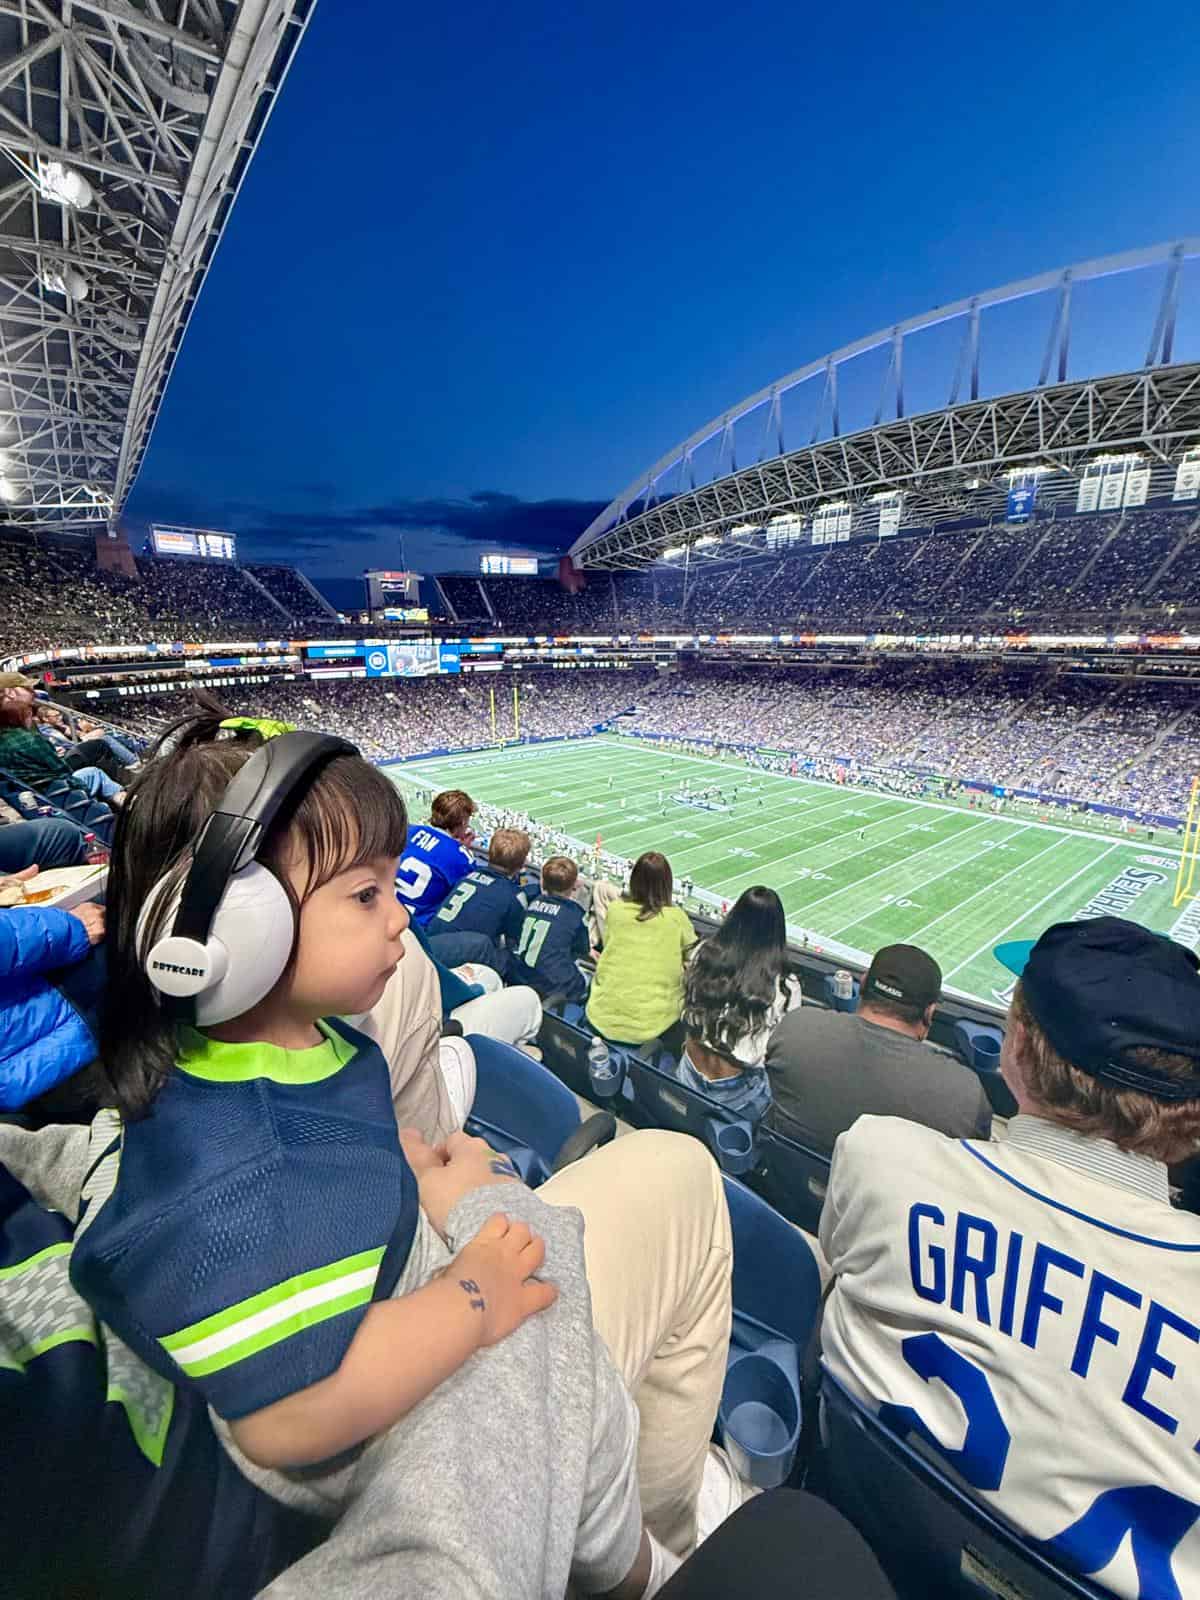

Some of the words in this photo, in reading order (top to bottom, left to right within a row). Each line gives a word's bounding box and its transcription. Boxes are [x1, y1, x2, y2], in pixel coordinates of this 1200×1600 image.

[118, 681, 175, 696] WELCOME
[199, 677, 235, 689] LUMEN
[239, 675, 270, 685] FIELD
[410, 830, 440, 852] FAN
[436, 882, 477, 923] 3
[1072, 866, 1168, 921] SEAHA
[514, 916, 551, 968] 11
[908, 1202, 1200, 1454] GRIFFE
